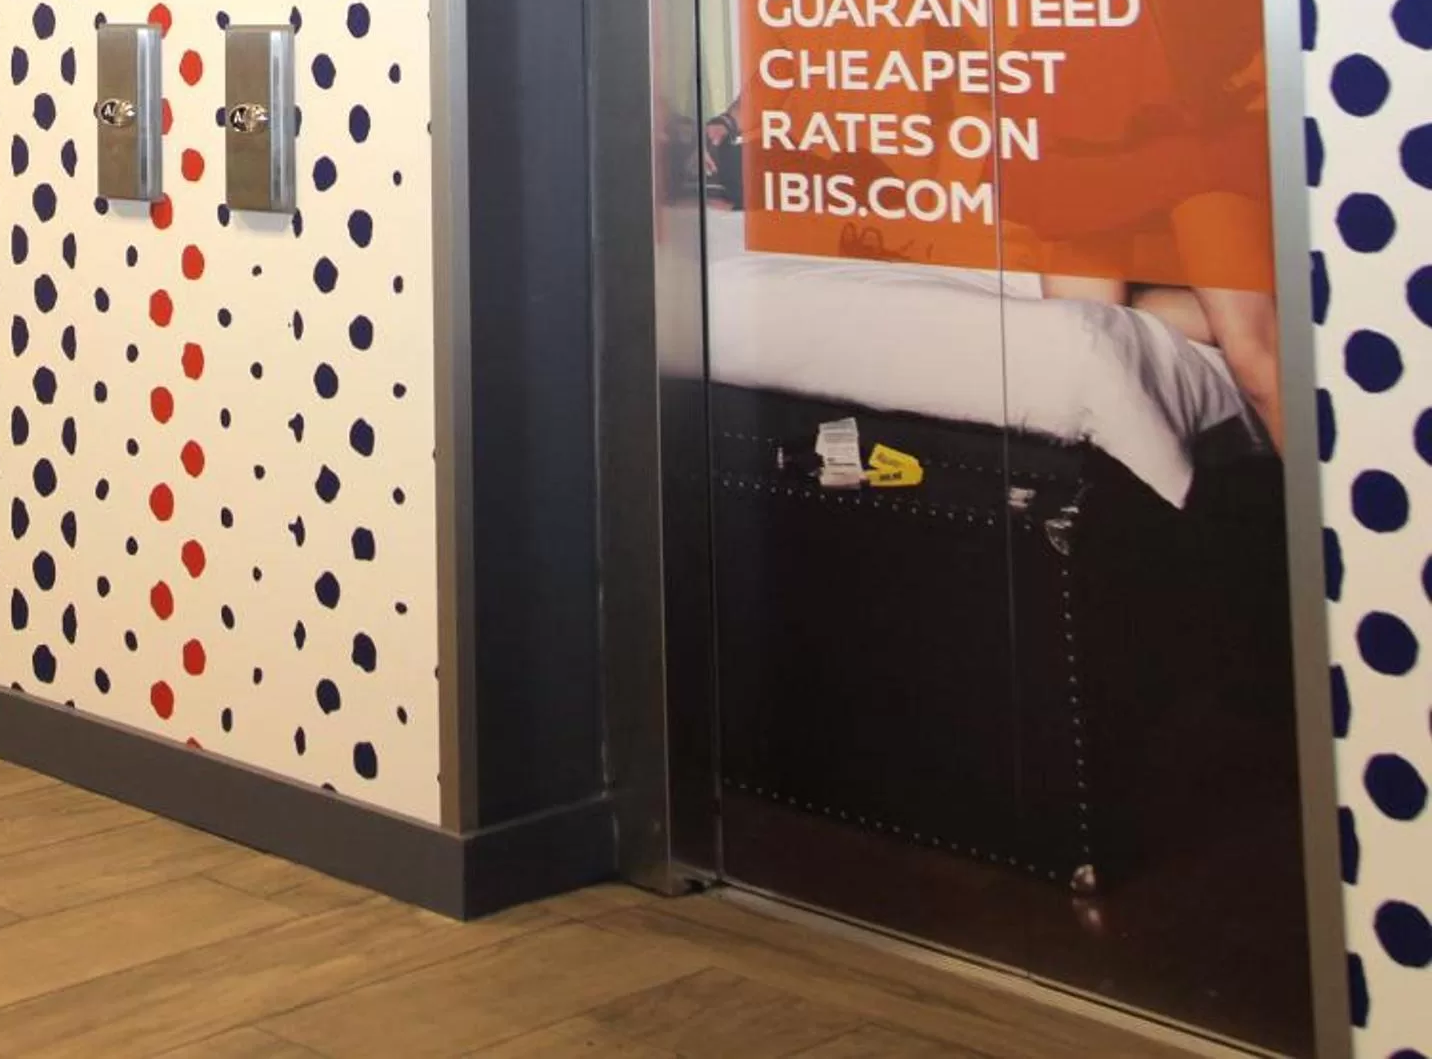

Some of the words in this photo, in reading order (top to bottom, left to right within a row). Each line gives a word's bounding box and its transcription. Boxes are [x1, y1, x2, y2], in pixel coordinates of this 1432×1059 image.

[759, 49, 1065, 94] CHEAPEST
[761, 110, 934, 156] RATES
[948, 117, 1040, 161] ON
[764, 171, 995, 226] IBIS.COM
